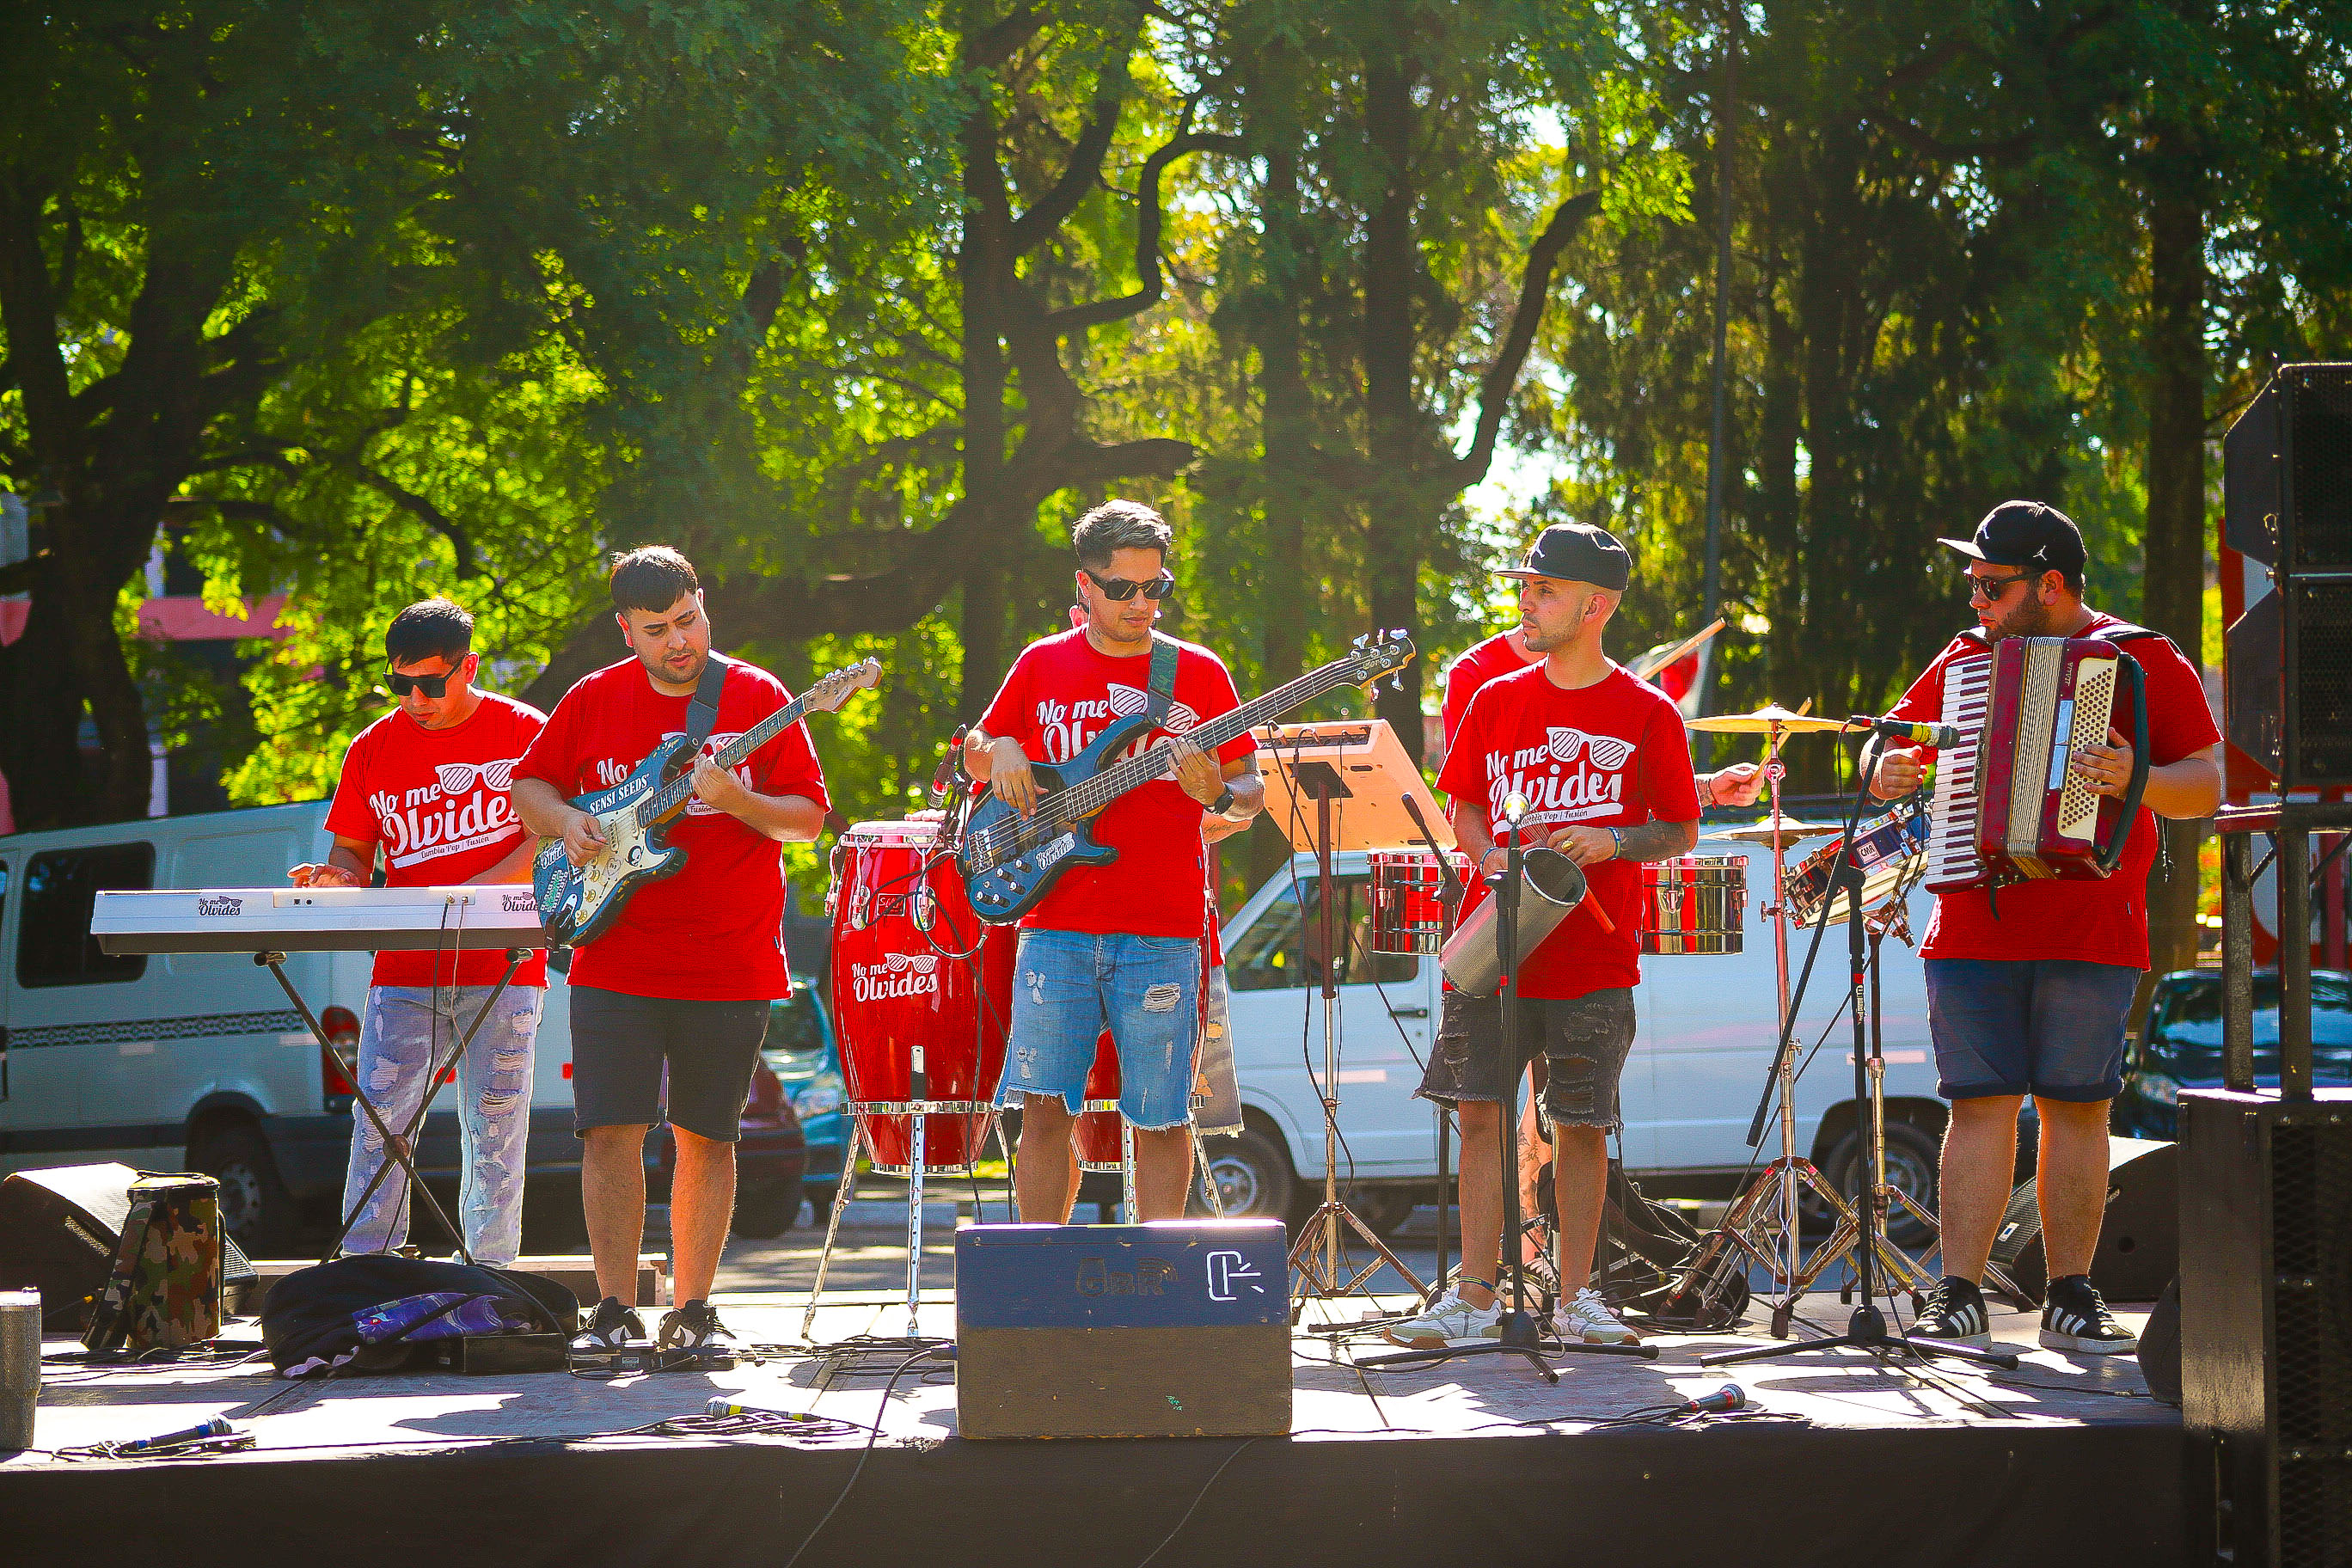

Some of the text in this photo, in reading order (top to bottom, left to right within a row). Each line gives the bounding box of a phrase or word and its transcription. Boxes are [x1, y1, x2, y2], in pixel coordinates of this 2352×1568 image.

[1037, 698, 1109, 726] No me
[1513, 744, 1548, 769] me
[597, 757, 628, 786] No
[370, 783, 442, 820] No me
[589, 774, 648, 816] SENSI SEEDS
[1544, 812, 1559, 821] Pop
[421, 846, 445, 859] Cumbia
[542, 840, 565, 868] Olvid
[1860, 844, 1875, 857] CMR
[198, 904, 241, 916] Olvides
[502, 900, 539, 911] Olvide
[852, 963, 889, 978] No me
[853, 971, 939, 1002] Olvides
